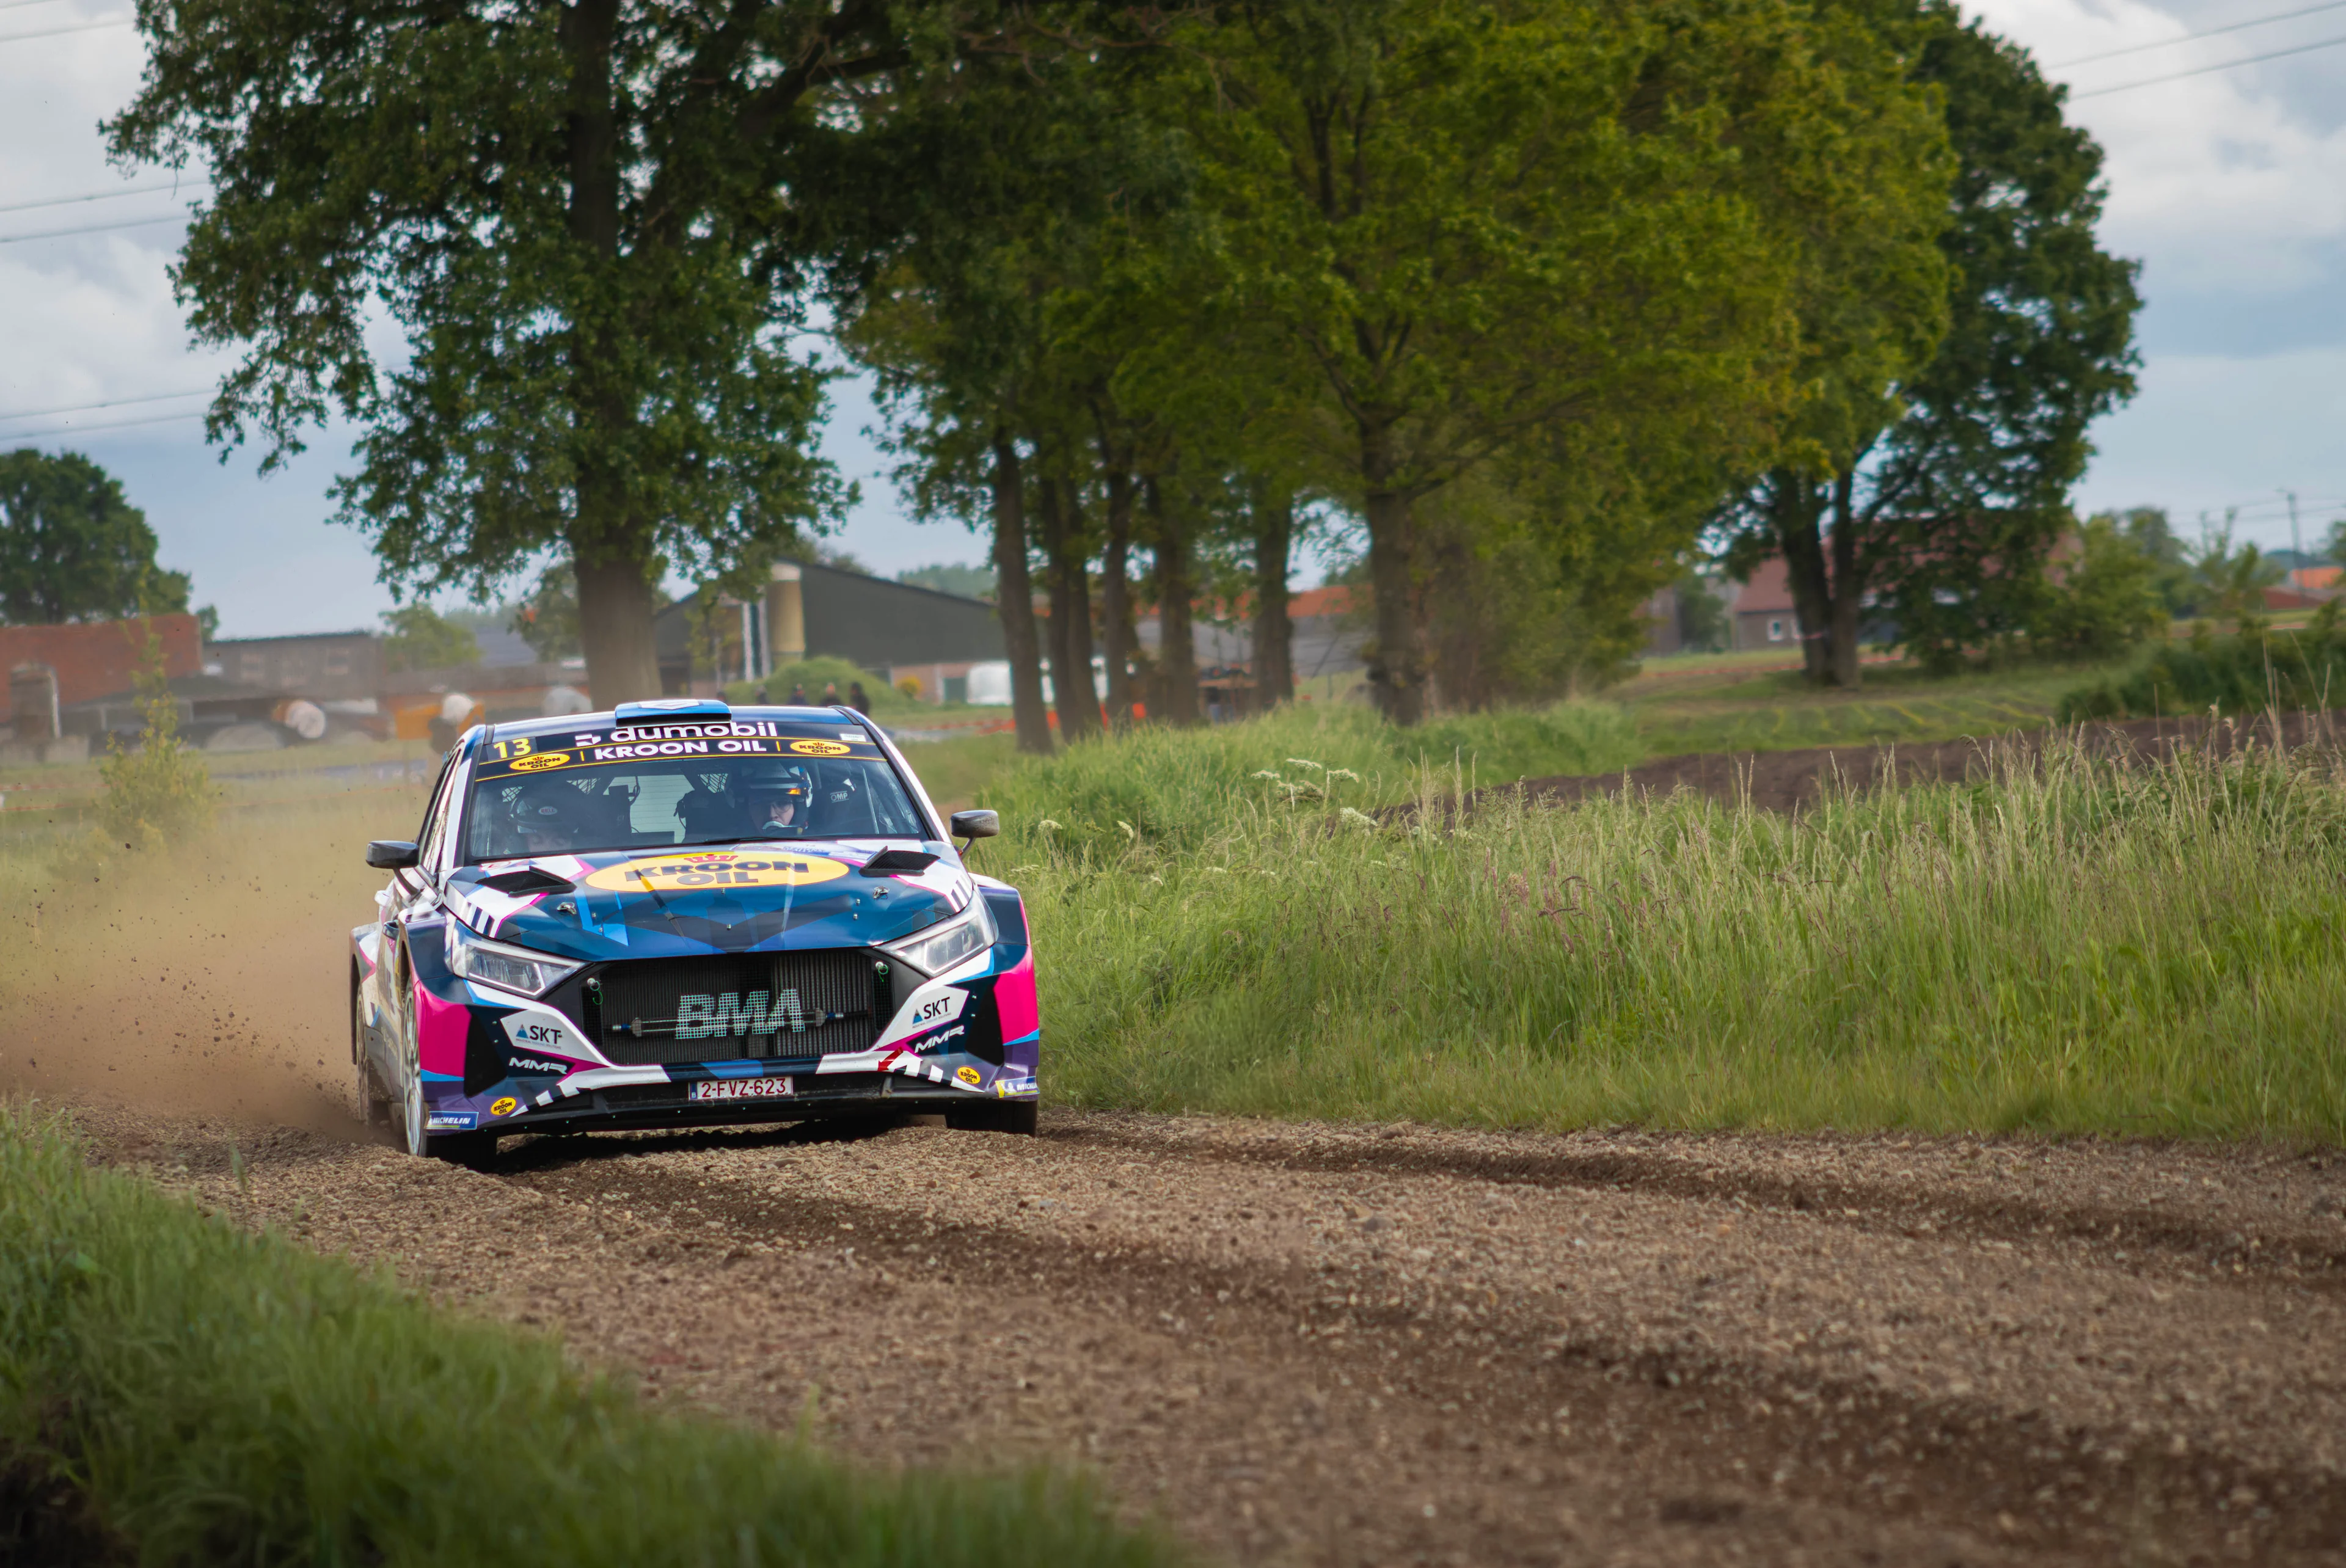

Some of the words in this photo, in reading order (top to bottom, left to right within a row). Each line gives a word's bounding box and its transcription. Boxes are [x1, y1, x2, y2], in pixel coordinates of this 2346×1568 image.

[611, 723, 778, 742] dumobil
[494, 738, 531, 759] 13
[595, 741, 708, 760] KROON
[718, 740, 767, 752] OIL
[519, 757, 560, 767] KROON
[624, 861, 809, 881] KROON
[677, 872, 758, 884] OIL
[675, 988, 805, 1039] BMA
[924, 996, 950, 1019] SKT
[530, 1026, 561, 1044] SKT
[915, 1025, 965, 1053] MMR
[509, 1057, 567, 1074] MMR
[960, 1071, 977, 1079] KROON
[701, 1078, 786, 1098] 2-FVZ-623
[494, 1101, 513, 1111] KROON
